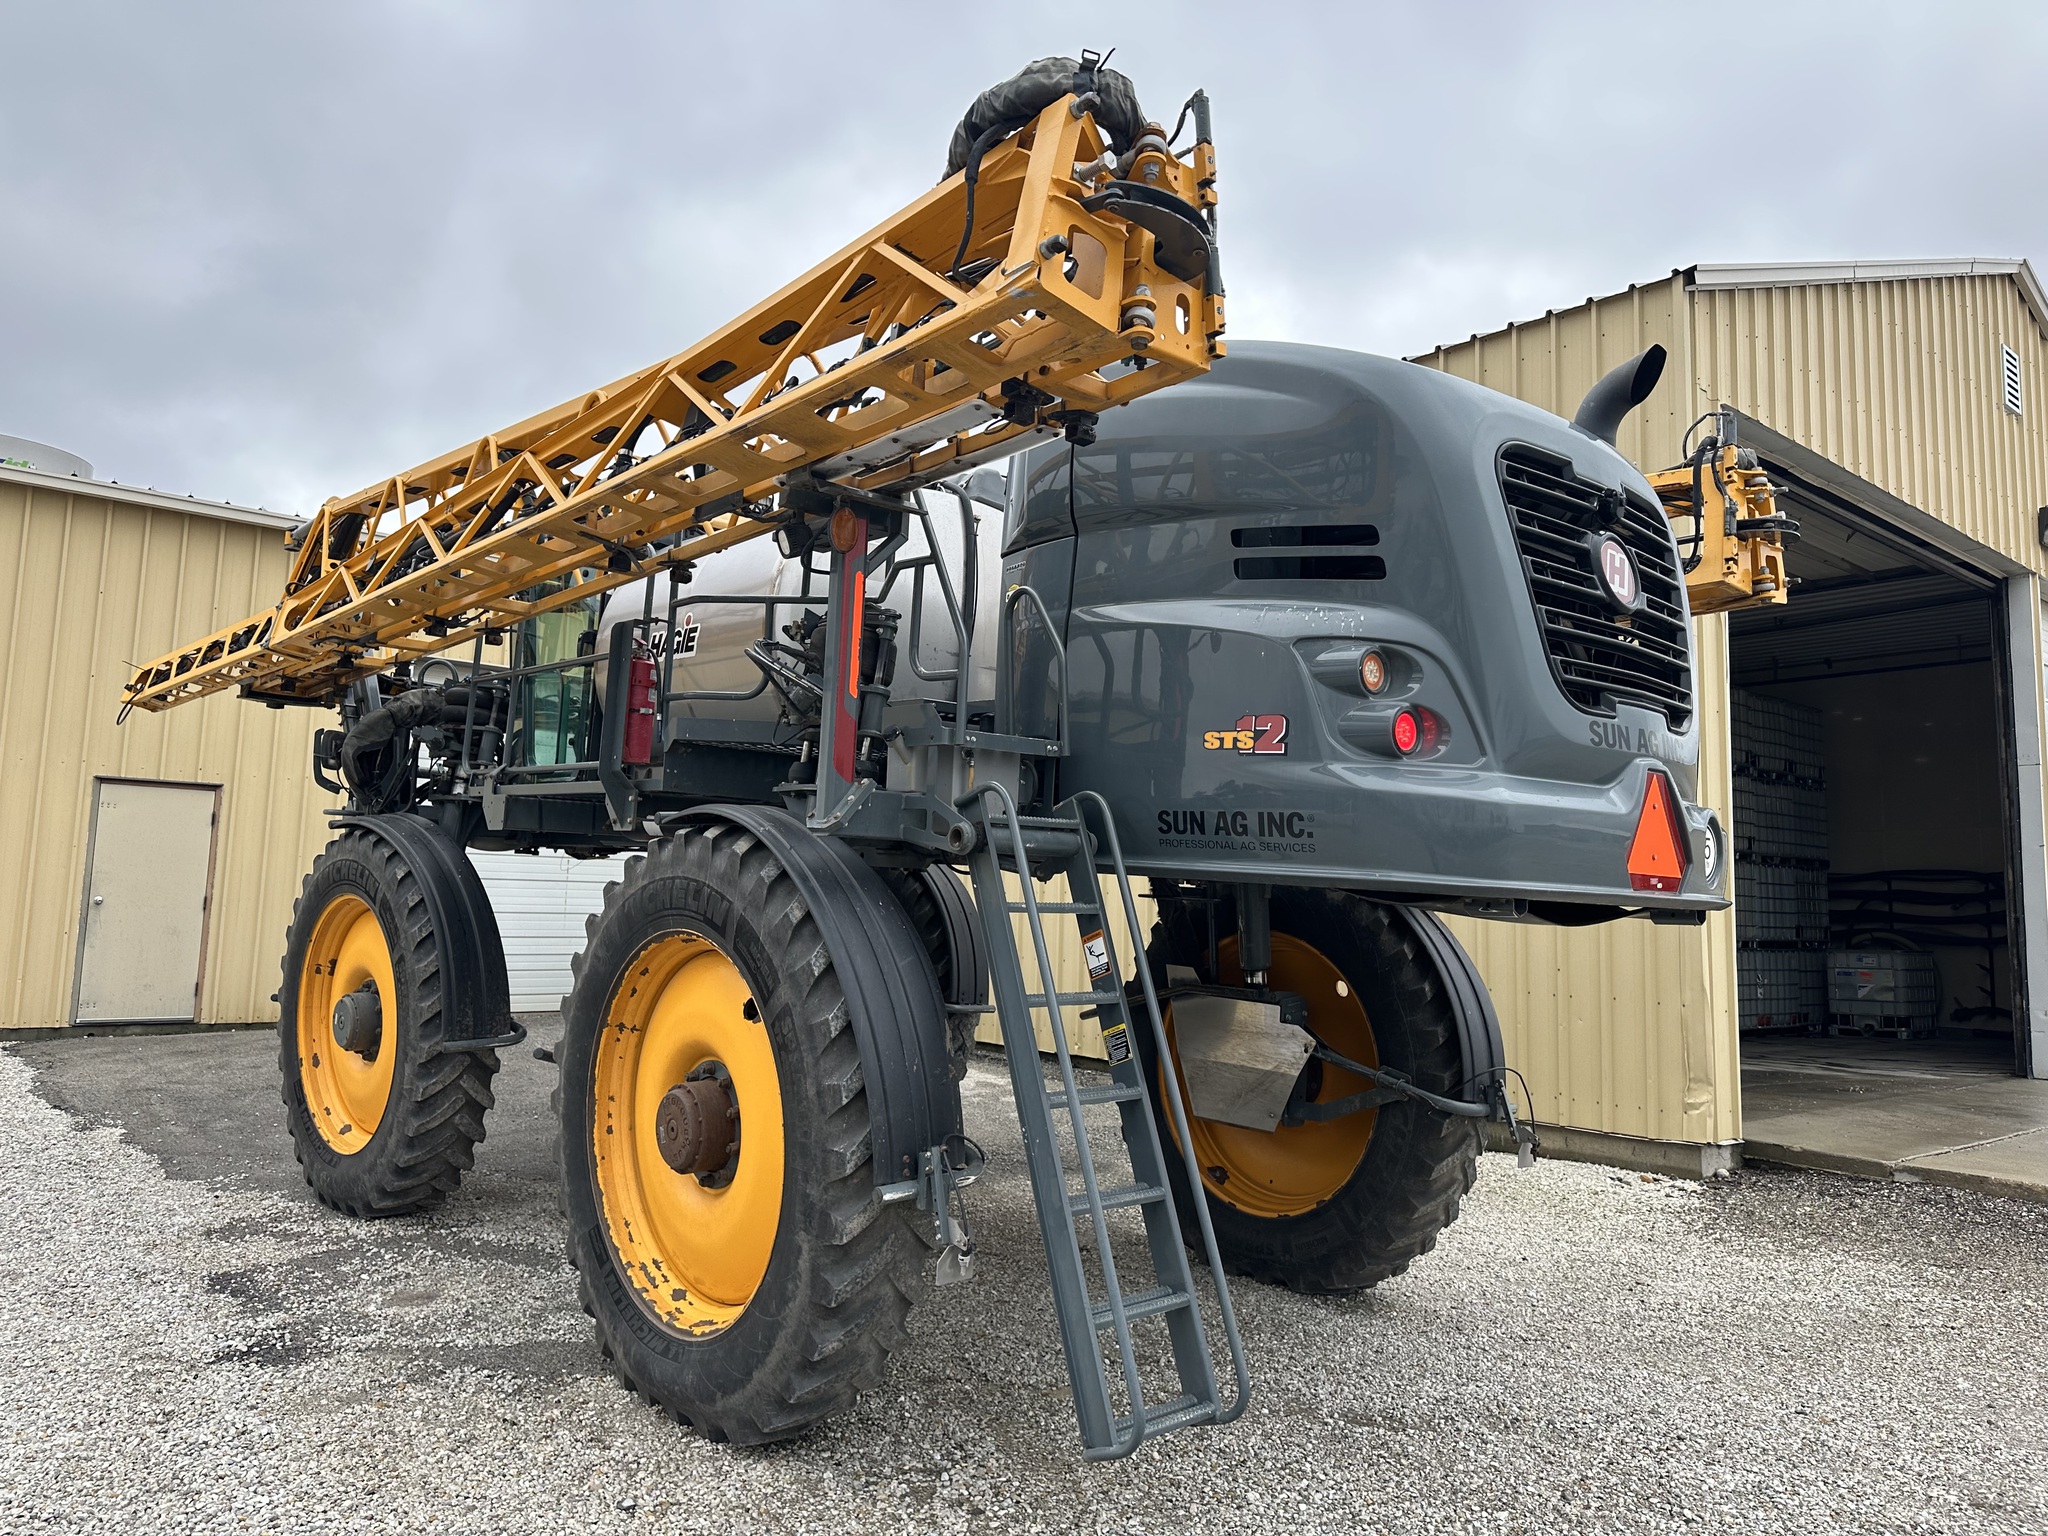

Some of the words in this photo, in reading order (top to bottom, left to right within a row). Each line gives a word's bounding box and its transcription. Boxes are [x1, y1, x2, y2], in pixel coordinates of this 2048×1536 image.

[1203, 730, 1254, 750] STS
[1589, 721, 1631, 751] SUN
[1637, 728, 1659, 757] AG
[1158, 810, 1205, 835] SUN
[1214, 811, 1248, 837] AG
[1159, 839, 1237, 850] PROFESSIONAL
[1240, 841, 1256, 851] AG
[1259, 842, 1316, 853] SERVICES
[604, 1273, 669, 1354] MICHELIN
